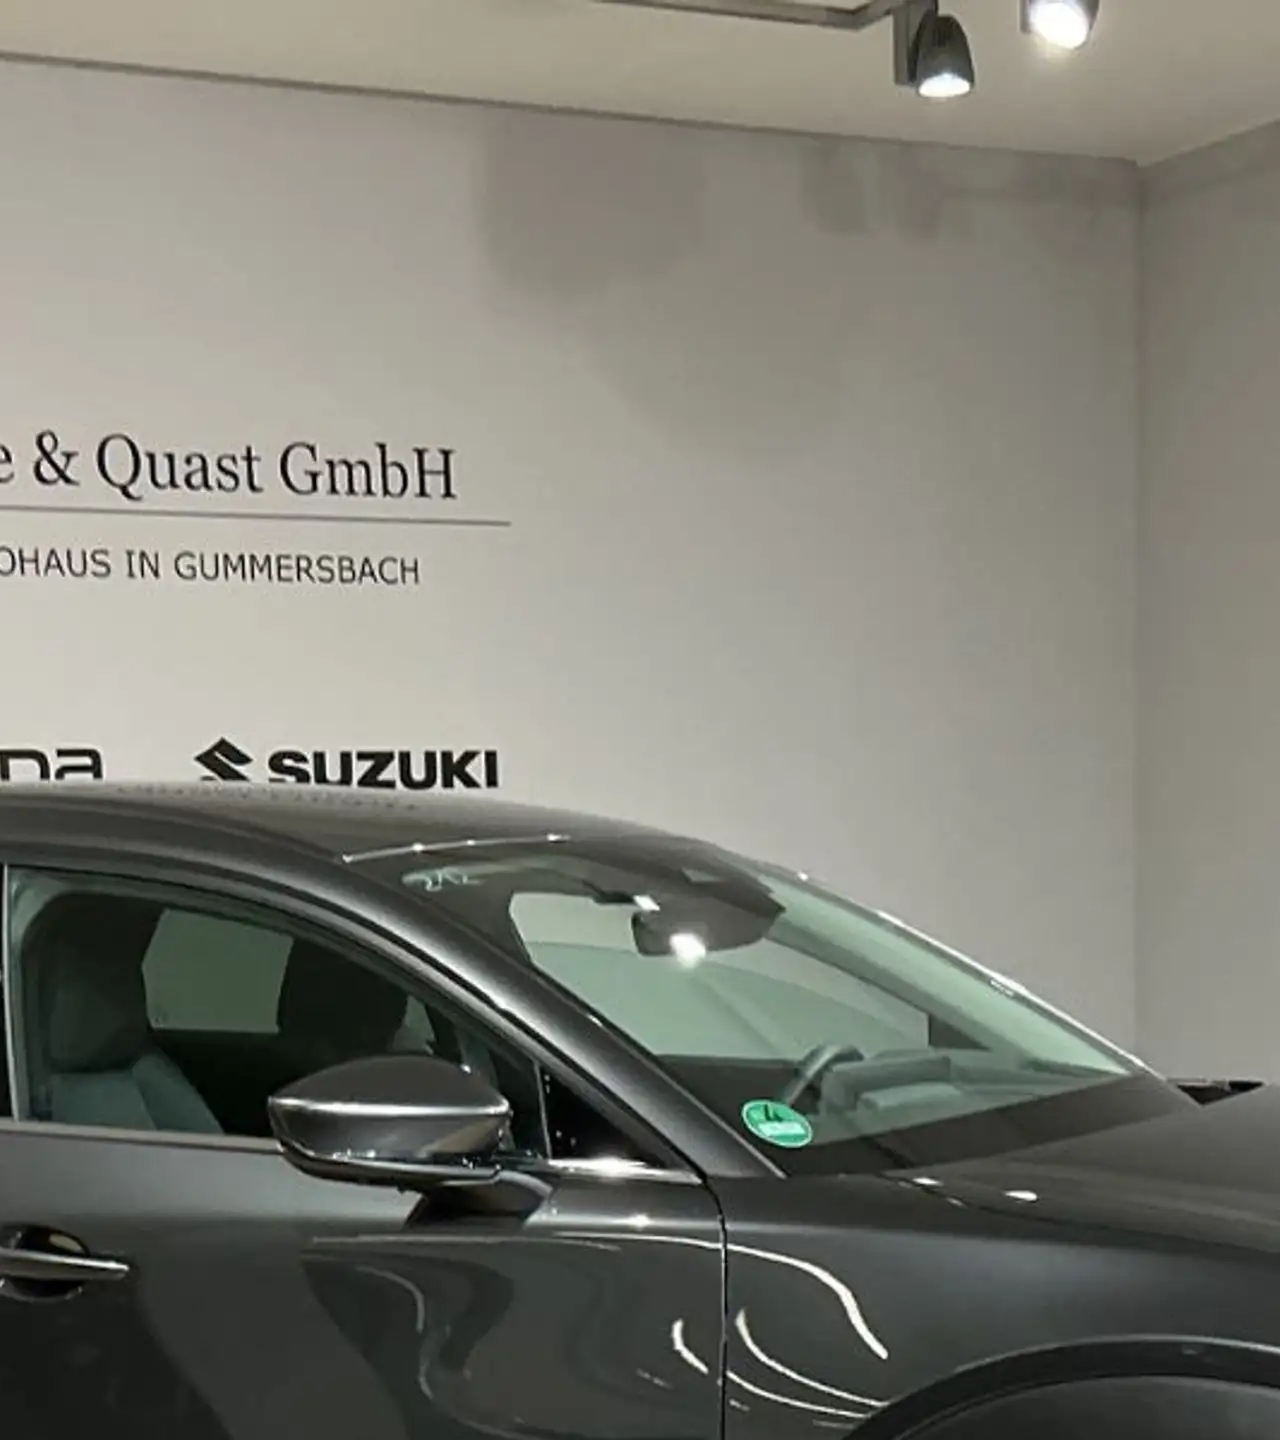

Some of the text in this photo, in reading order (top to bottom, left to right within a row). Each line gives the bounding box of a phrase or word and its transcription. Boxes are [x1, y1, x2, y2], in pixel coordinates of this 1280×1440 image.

[32, 429, 80, 487] &
[96, 433, 264, 502] Quast
[279, 441, 458, 500] GmbH
[125, 549, 161, 580] IN
[173, 550, 420, 586] GUMMERSBACH
[267, 750, 498, 790] SUZUKI
